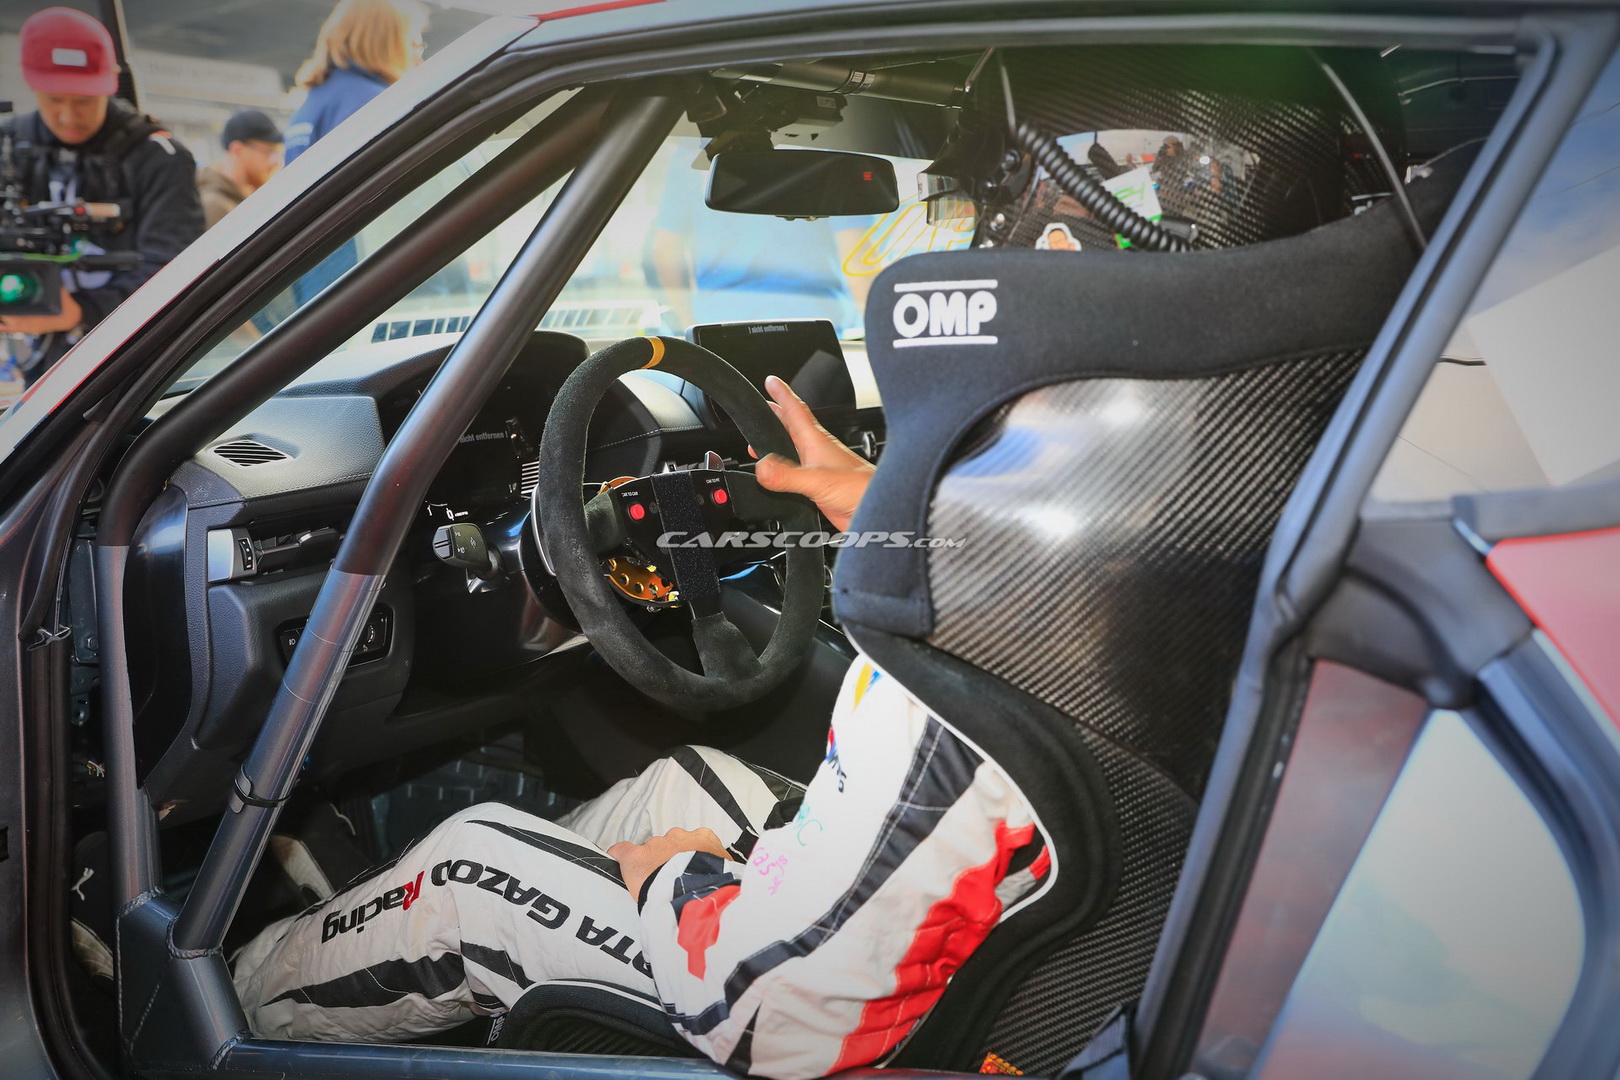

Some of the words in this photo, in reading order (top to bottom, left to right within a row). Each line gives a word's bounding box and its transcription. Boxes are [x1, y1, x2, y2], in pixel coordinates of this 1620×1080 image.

[893, 290, 998, 338] OMP
[321, 870, 425, 944] Racing
[431, 859, 571, 930] GAZOO
